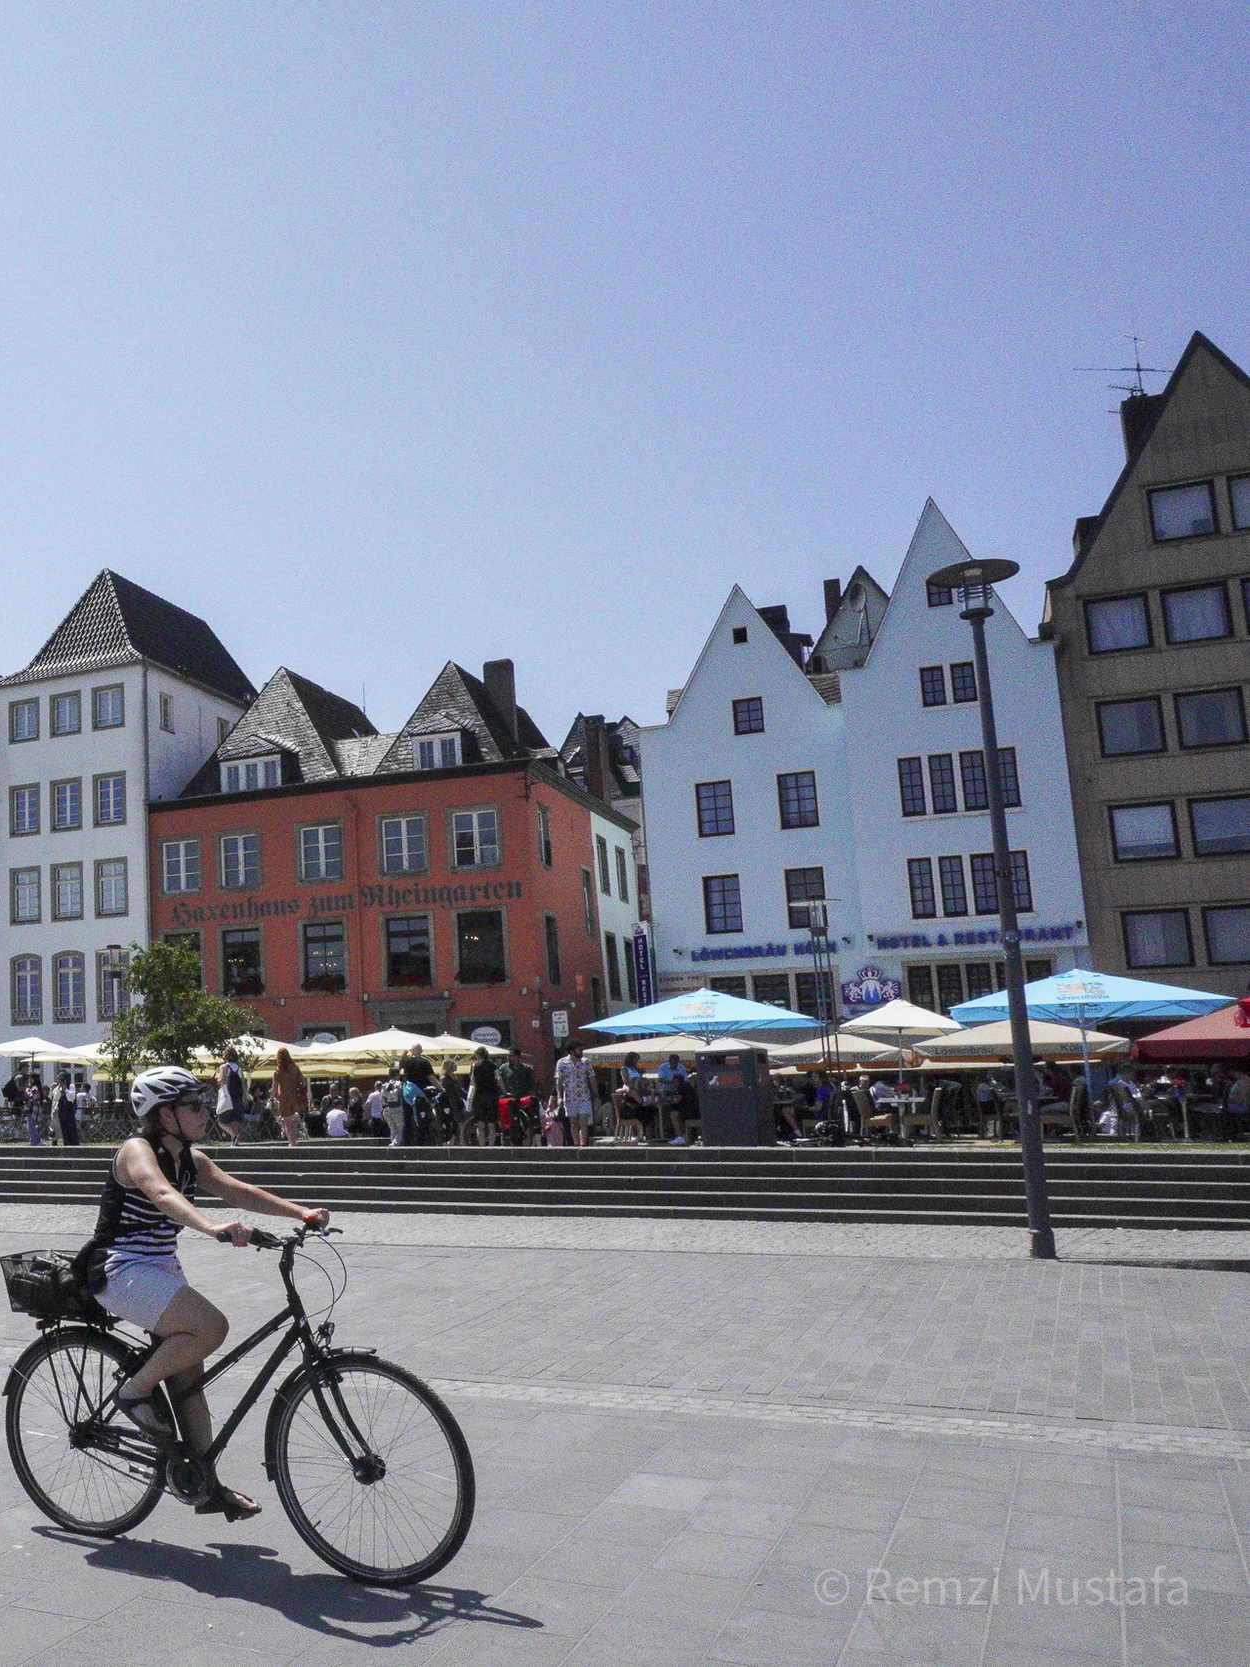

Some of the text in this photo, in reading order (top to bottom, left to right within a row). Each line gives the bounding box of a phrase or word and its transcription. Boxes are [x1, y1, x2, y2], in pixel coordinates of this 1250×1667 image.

[308, 894, 355, 918] zum
[360, 881, 523, 909] Rheingarten
[877, 926, 1072, 949] HOTEL & RESTRANT
[637, 938, 645, 970] HOTEL
